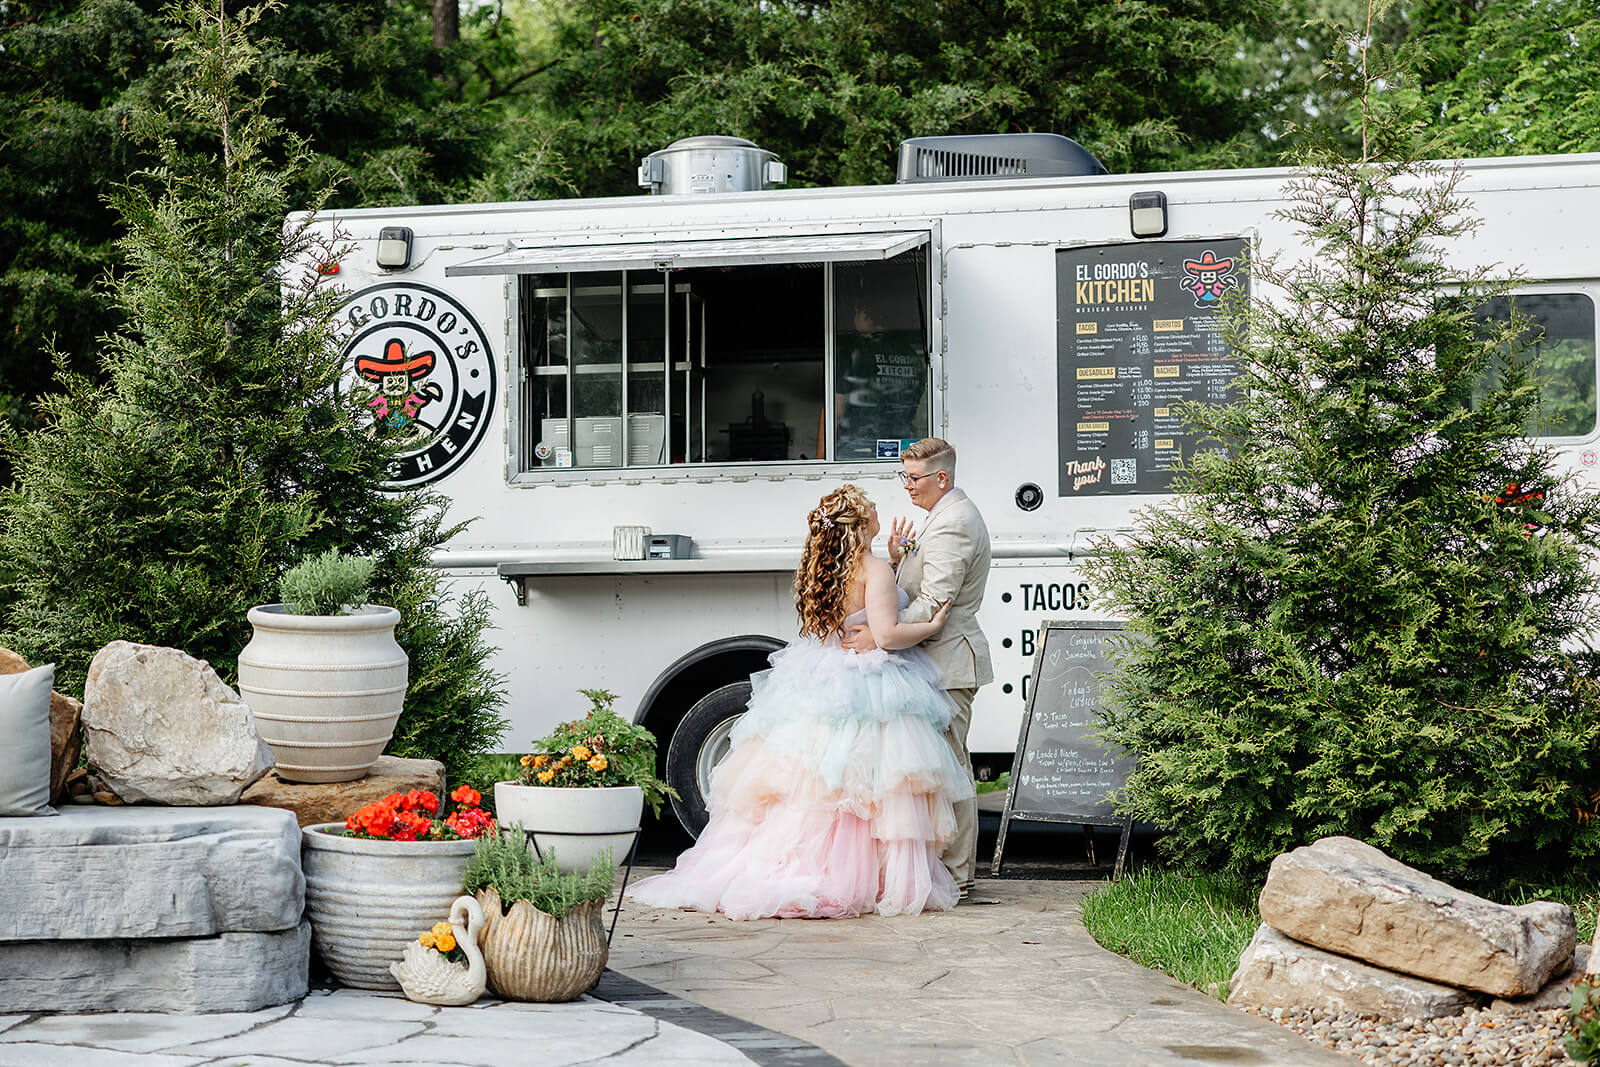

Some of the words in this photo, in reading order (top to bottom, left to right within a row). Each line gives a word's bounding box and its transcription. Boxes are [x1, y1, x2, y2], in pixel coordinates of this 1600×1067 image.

[1076, 265, 1092, 281] EL
[1094, 261, 1149, 280] GORDO'S
[1076, 279, 1154, 305] KITCHEN
[349, 294, 479, 359] GORDO'S
[1078, 323, 1096, 331] TACOS
[1155, 320, 1182, 329] BURRITOS
[1079, 369, 1114, 377] QUESADILLAS
[1156, 366, 1178, 375] NACHOS
[1065, 455, 1106, 476] Thank
[1073, 469, 1102, 491] you!
[1020, 583, 1091, 611] TACOS
[1036, 749, 1058, 760] Loaded
